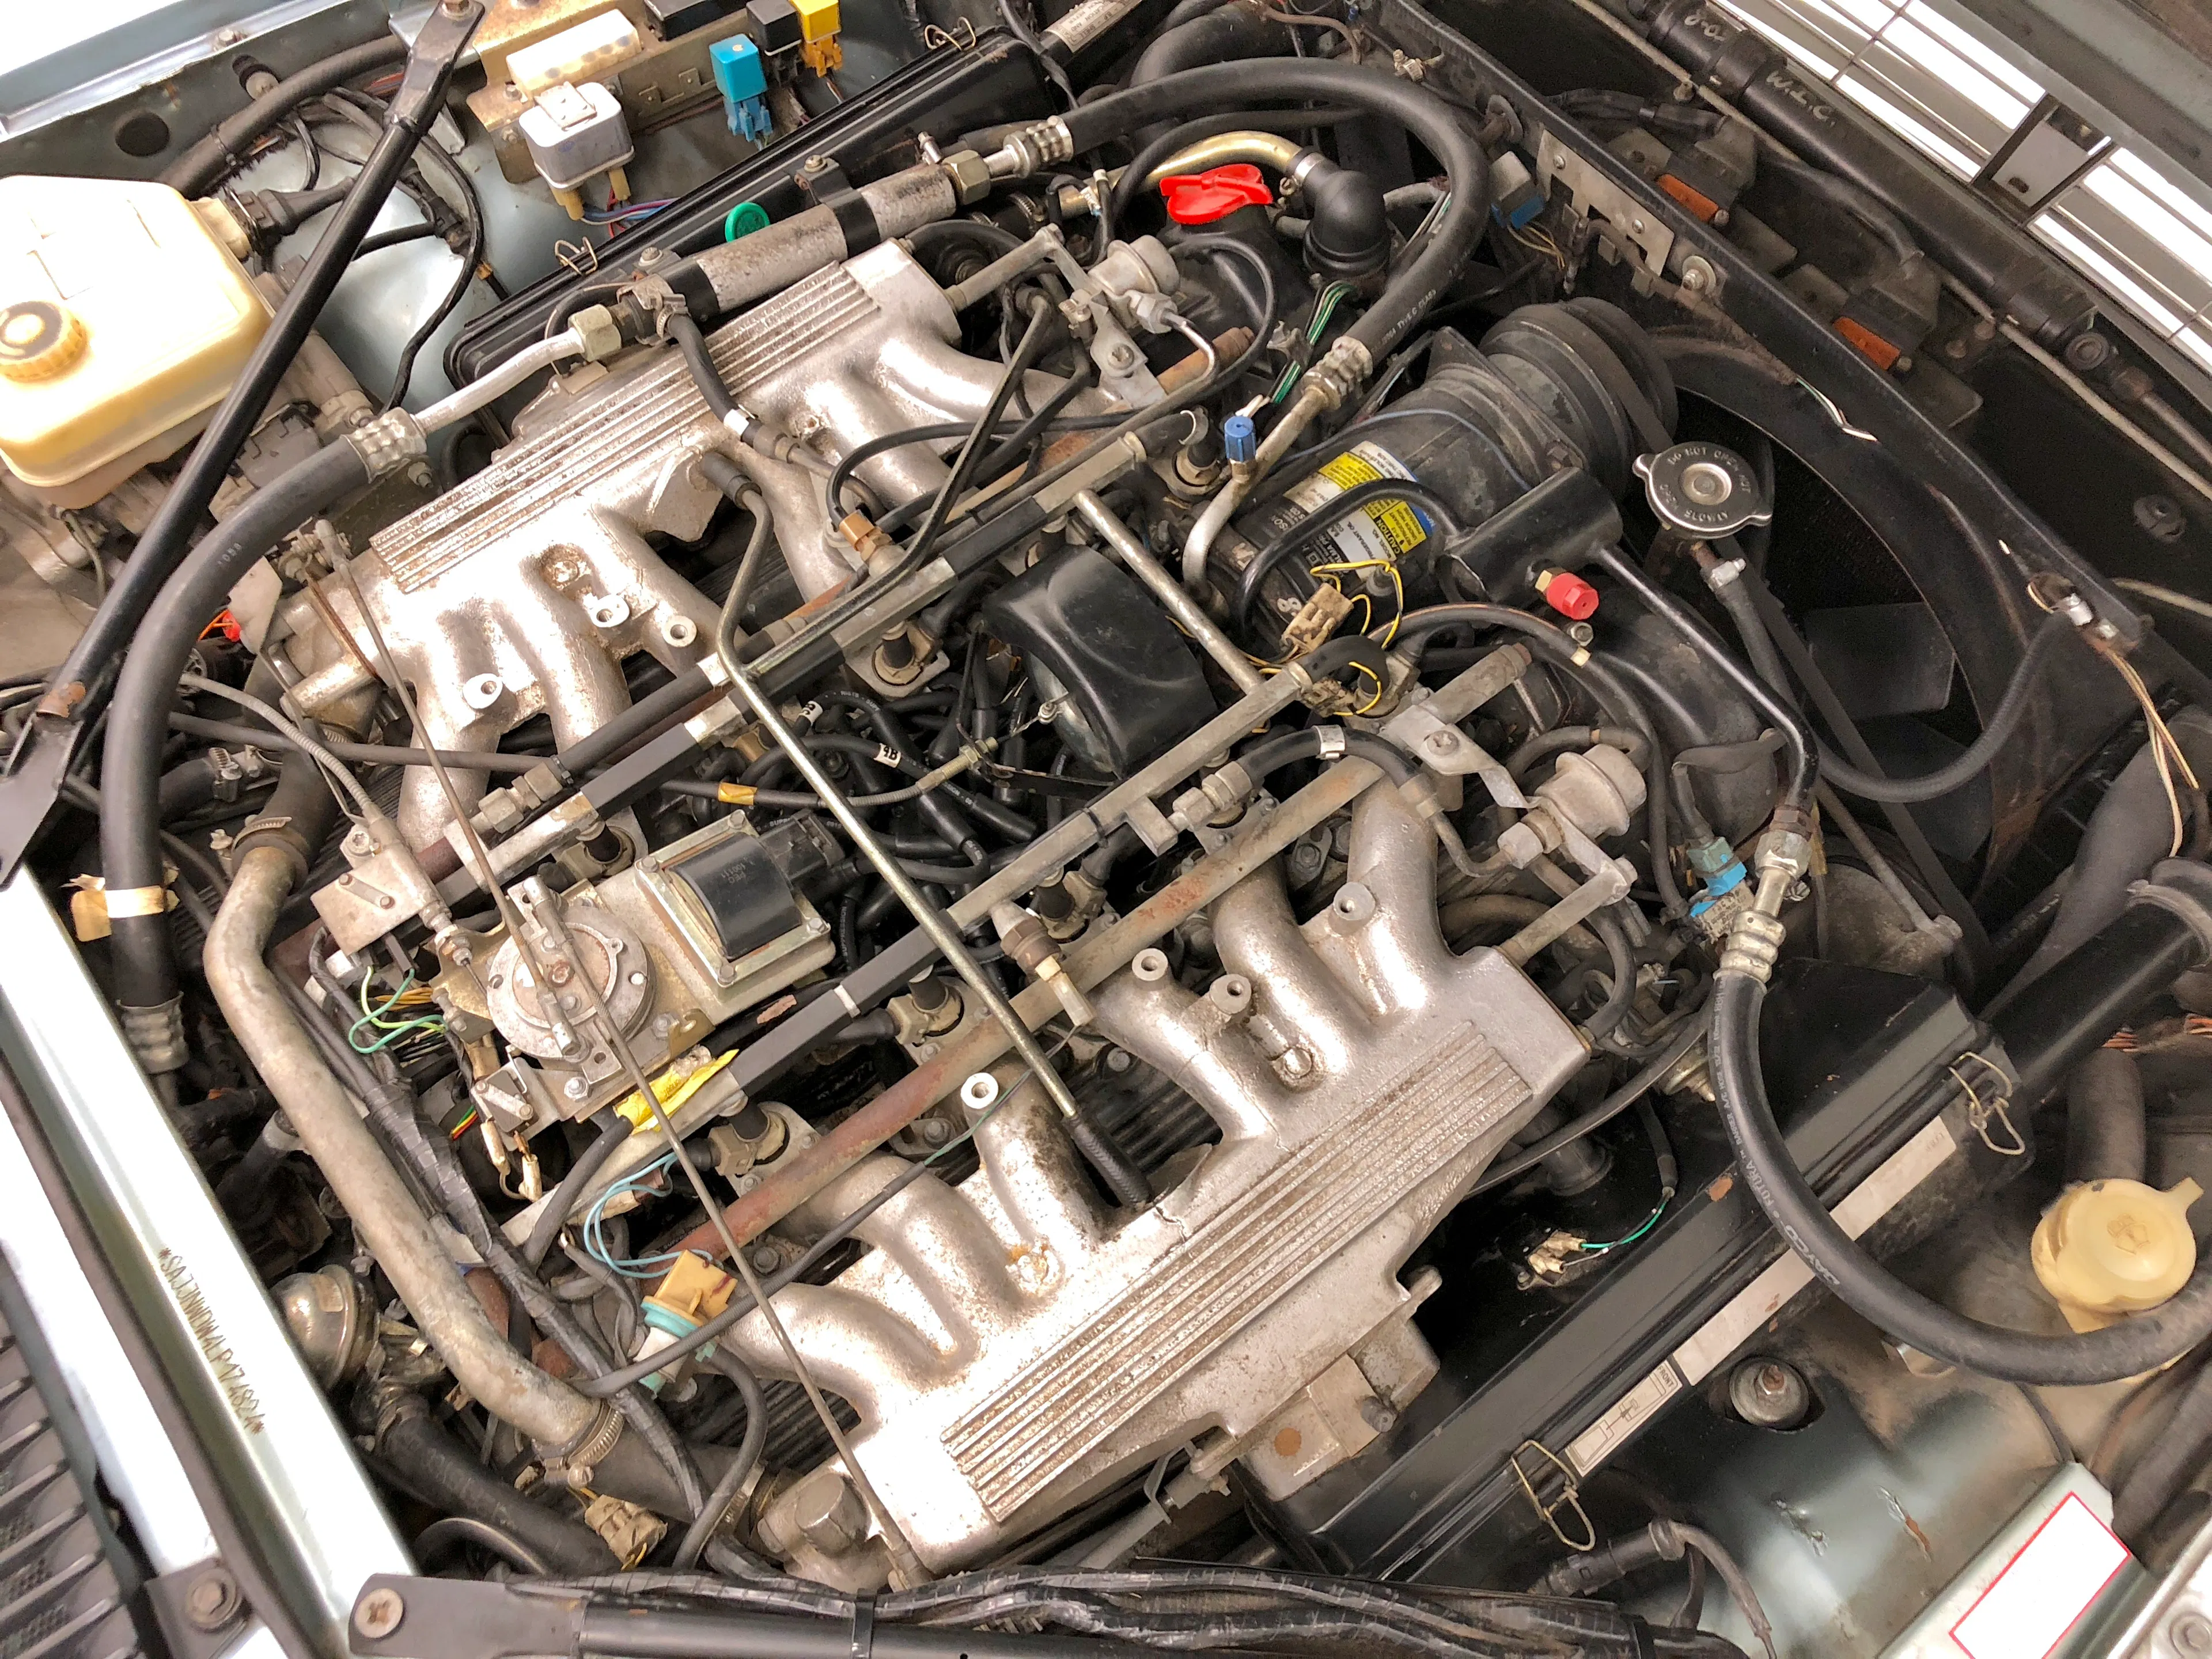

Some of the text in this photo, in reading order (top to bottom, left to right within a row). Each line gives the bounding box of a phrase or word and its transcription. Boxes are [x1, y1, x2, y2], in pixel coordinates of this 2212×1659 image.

[1079, 23, 1096, 39] SHELL
[1684, 446, 1707, 456] NOT
[1389, 512, 1412, 546] REFRIGERANT
[1402, 506, 1422, 534] PRESSURE
[1684, 509, 1728, 522] SLOWLY
[1370, 528, 1392, 559] MODEL NO.
[1376, 518, 1402, 554] CAUTION
[1404, 522, 1418, 541] UNDER
[1727, 1113, 1742, 1145] BARRIER
[1734, 1160, 1774, 1206] FUTURA
[1779, 1220, 1840, 1284] DAYCO
[1657, 1365, 1675, 1388] FRONT
